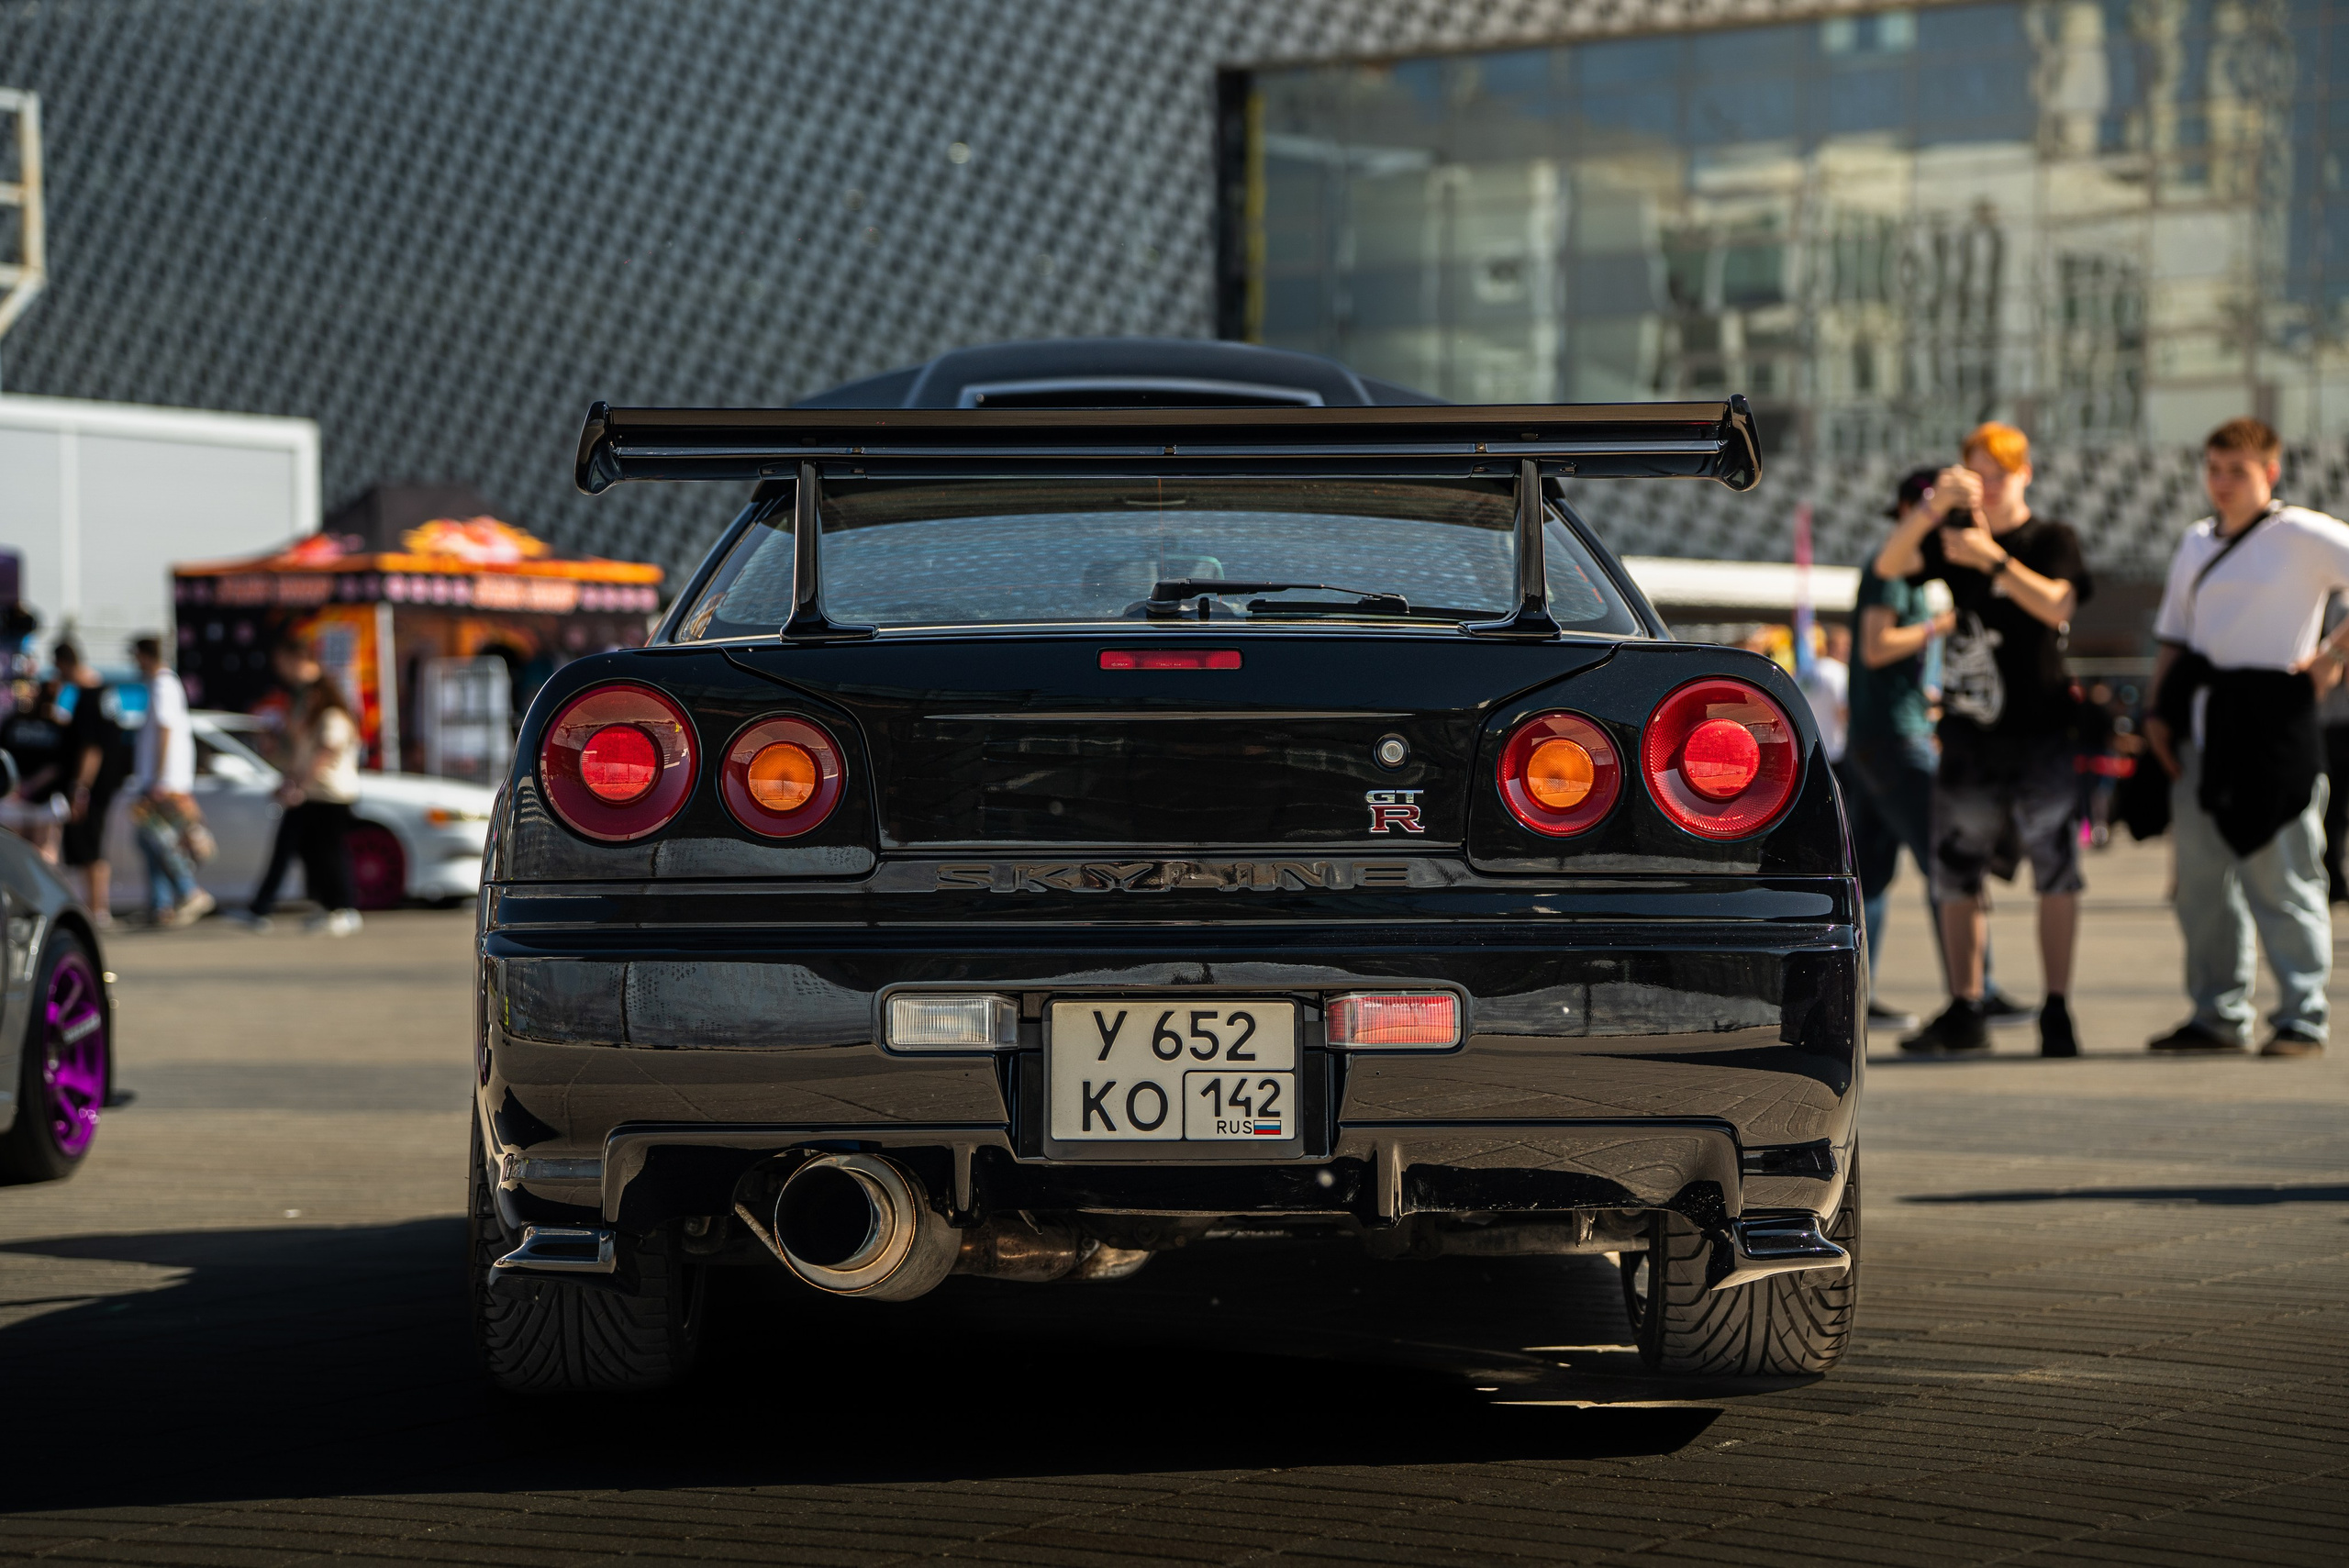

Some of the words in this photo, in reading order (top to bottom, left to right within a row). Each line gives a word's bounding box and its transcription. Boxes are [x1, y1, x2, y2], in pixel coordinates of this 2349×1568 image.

[1365, 789, 1424, 804] GT
[1367, 804, 1426, 833] R
[935, 862, 1410, 891] SKYLINE
[1152, 1010, 1256, 1062] 652
[1082, 1080, 1169, 1132] КО
[1199, 1077, 1281, 1118] 142
[1216, 1119, 1253, 1135] RUS
